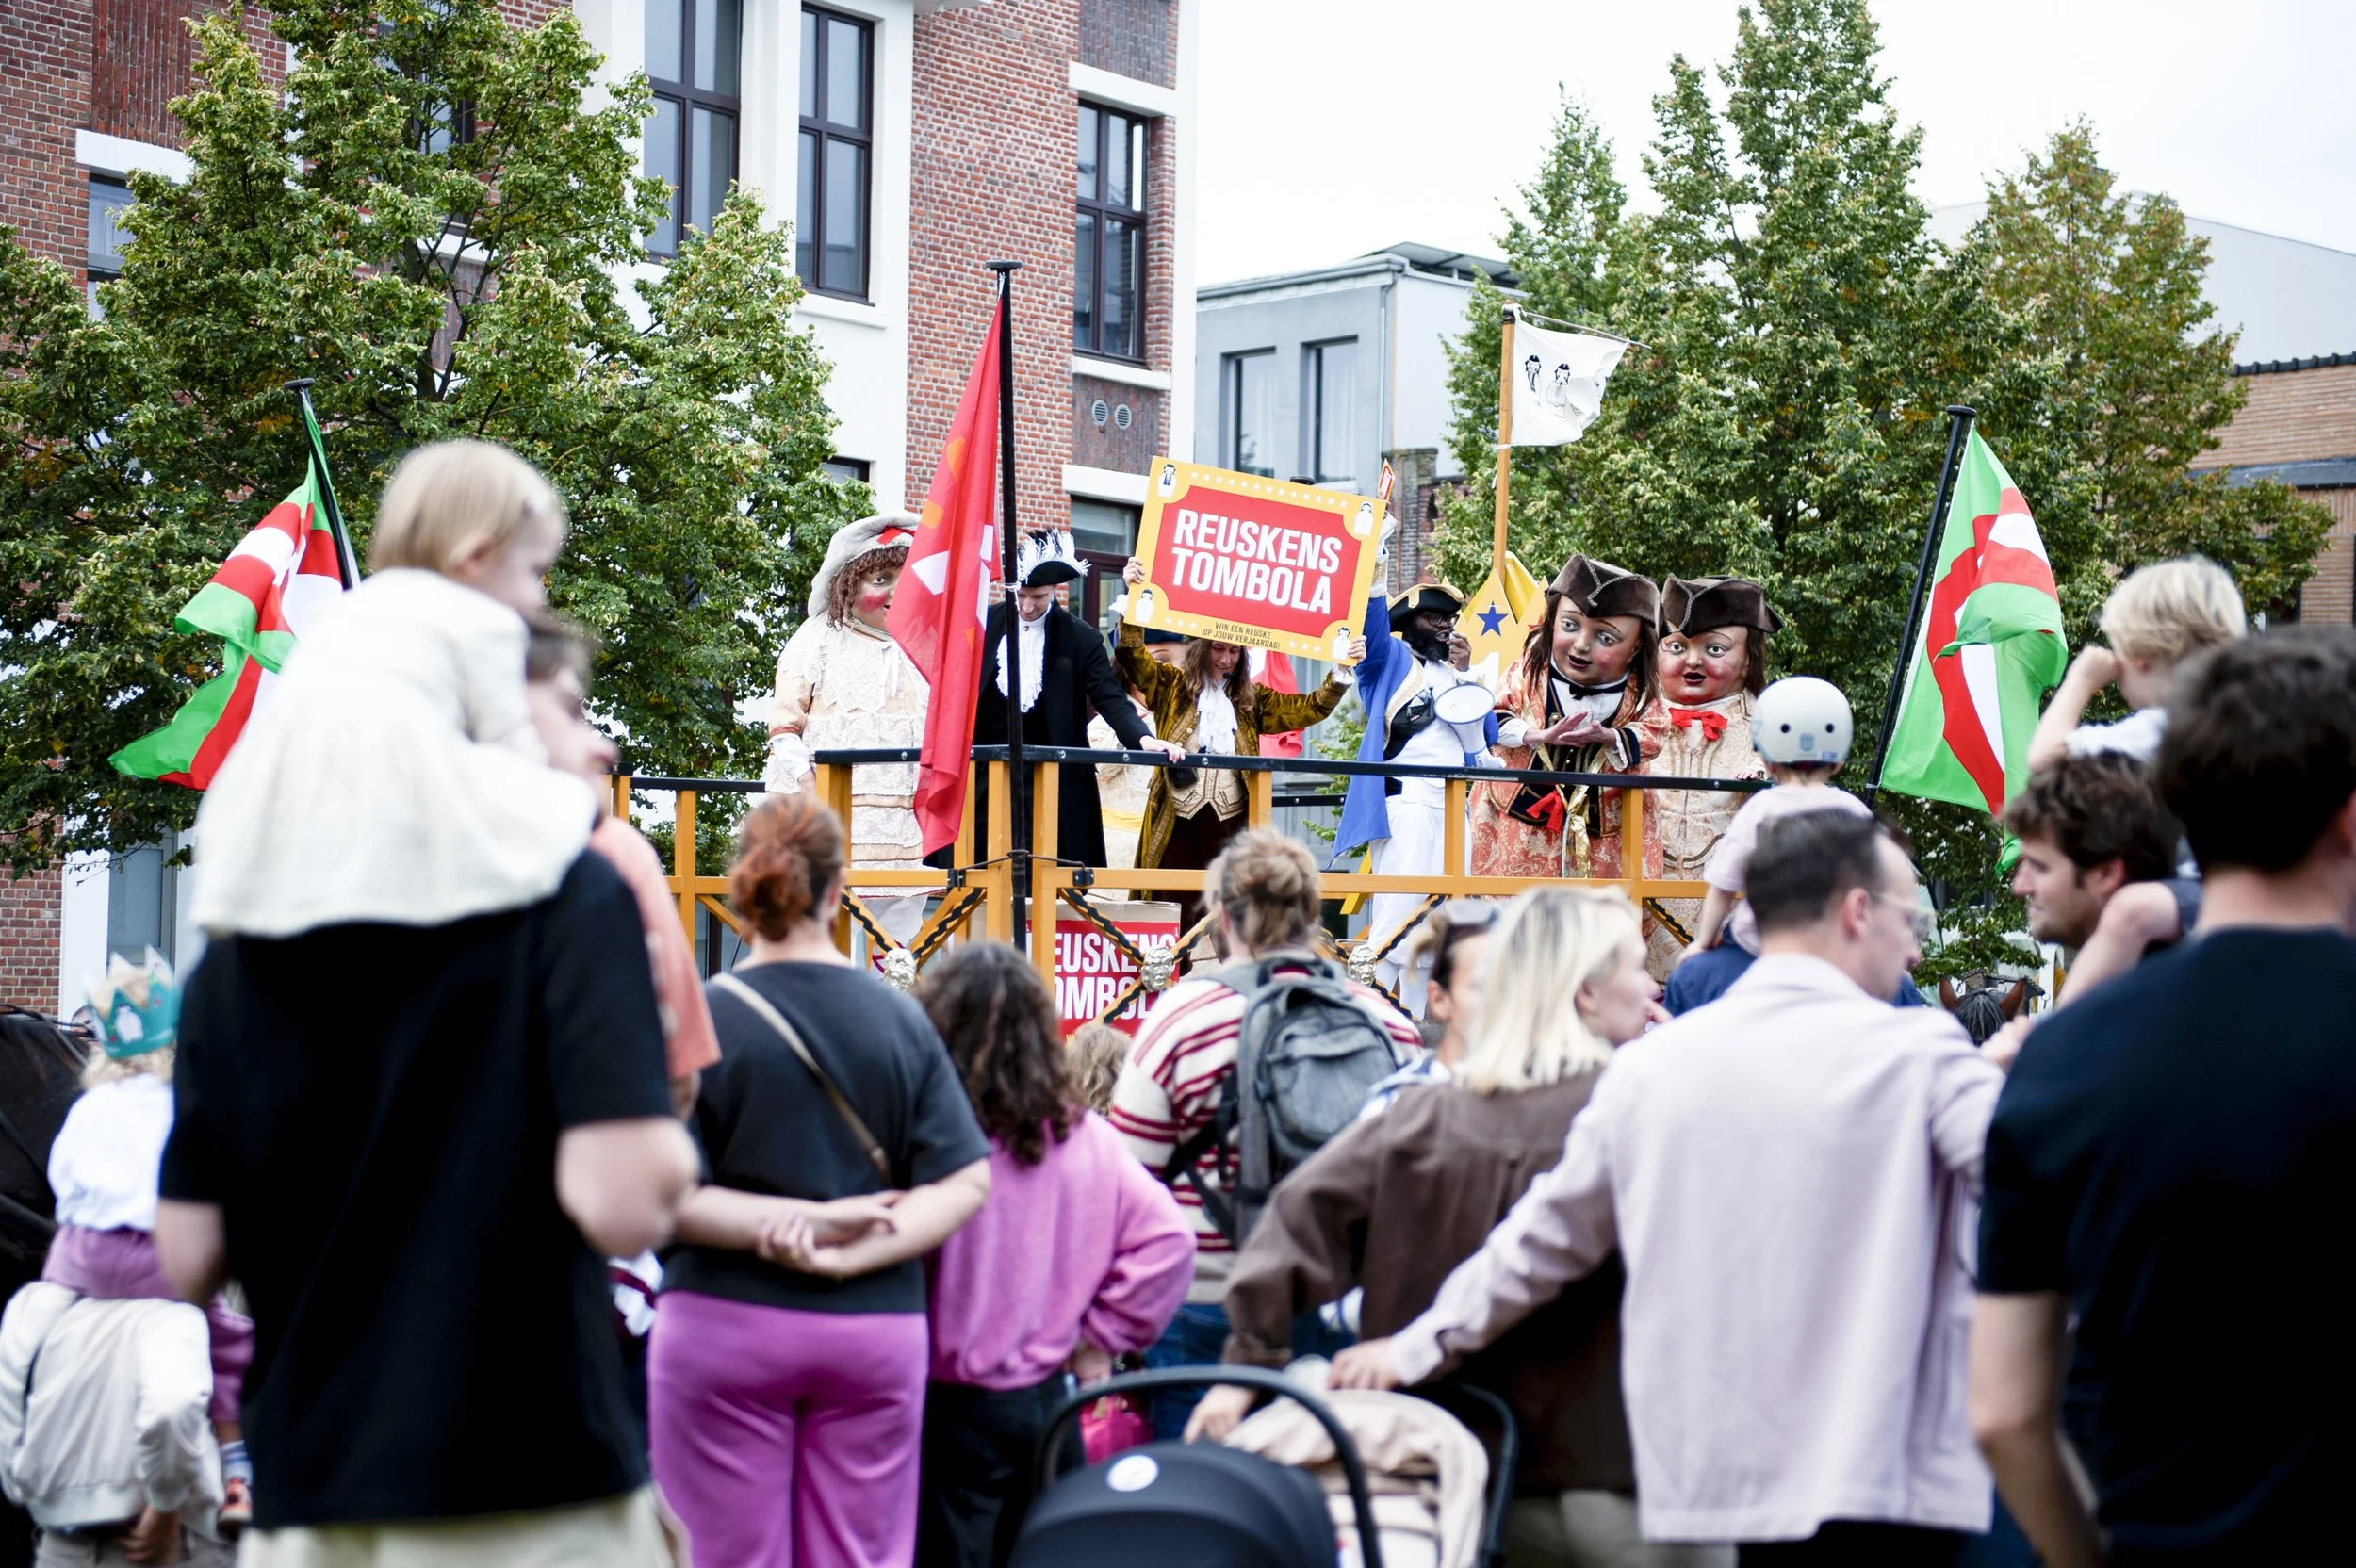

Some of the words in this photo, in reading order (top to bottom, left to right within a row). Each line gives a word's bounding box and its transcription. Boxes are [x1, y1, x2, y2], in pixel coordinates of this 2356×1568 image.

[1174, 508, 1343, 574] REUSKENS
[1171, 547, 1331, 615] TOMBOLA
[1213, 629, 1234, 640] JOUW
[1235, 633, 1281, 649] VERJAARDAG!
[1215, 622, 1229, 630] WIN
[1231, 624, 1244, 633] EEN
[1245, 627, 1272, 639] REUSKE
[1055, 975, 1153, 1020] OMBOL
